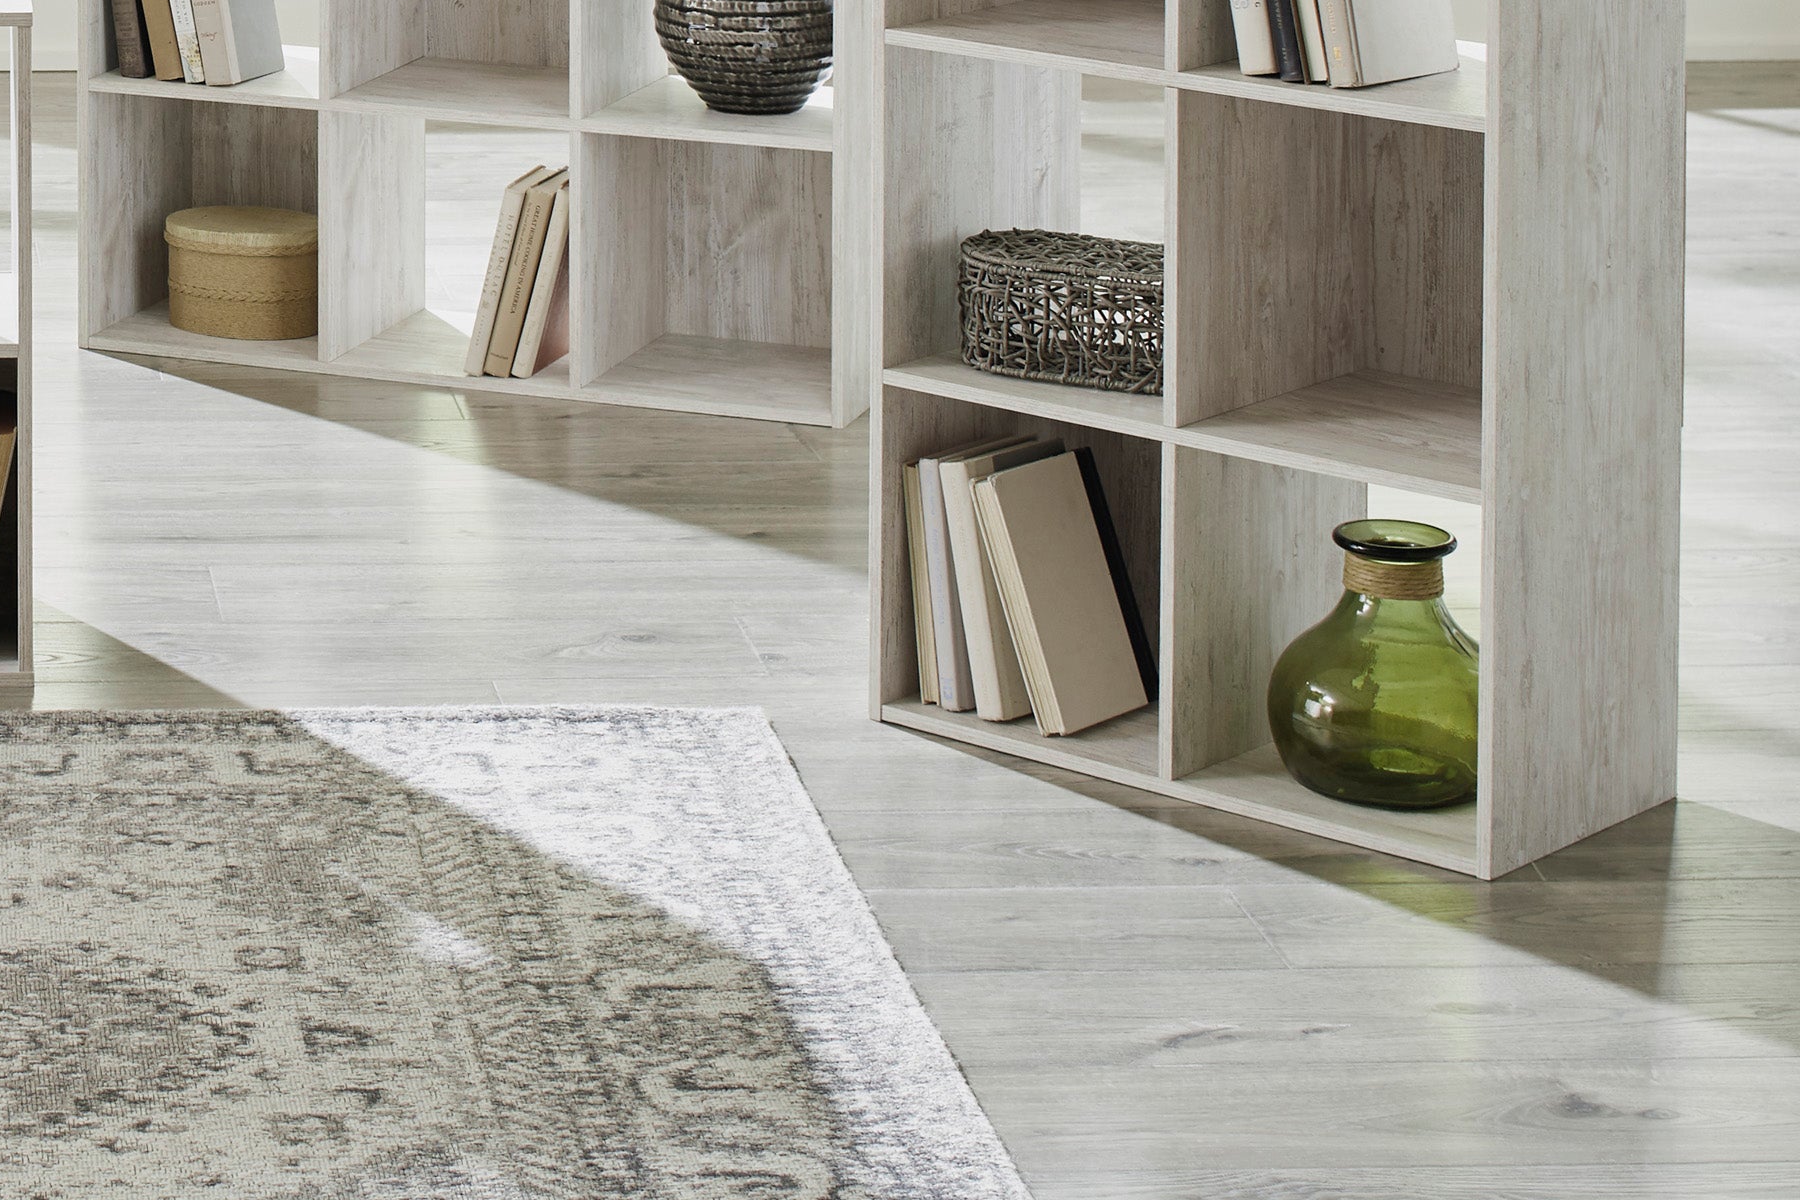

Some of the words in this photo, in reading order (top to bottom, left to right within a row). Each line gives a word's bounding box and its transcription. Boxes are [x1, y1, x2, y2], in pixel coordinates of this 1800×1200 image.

[531, 205, 541, 226] GREAT
[526, 225, 536, 247] HOME
[520, 246, 532, 278] COOKING
[509, 285, 522, 314] AMERICA
